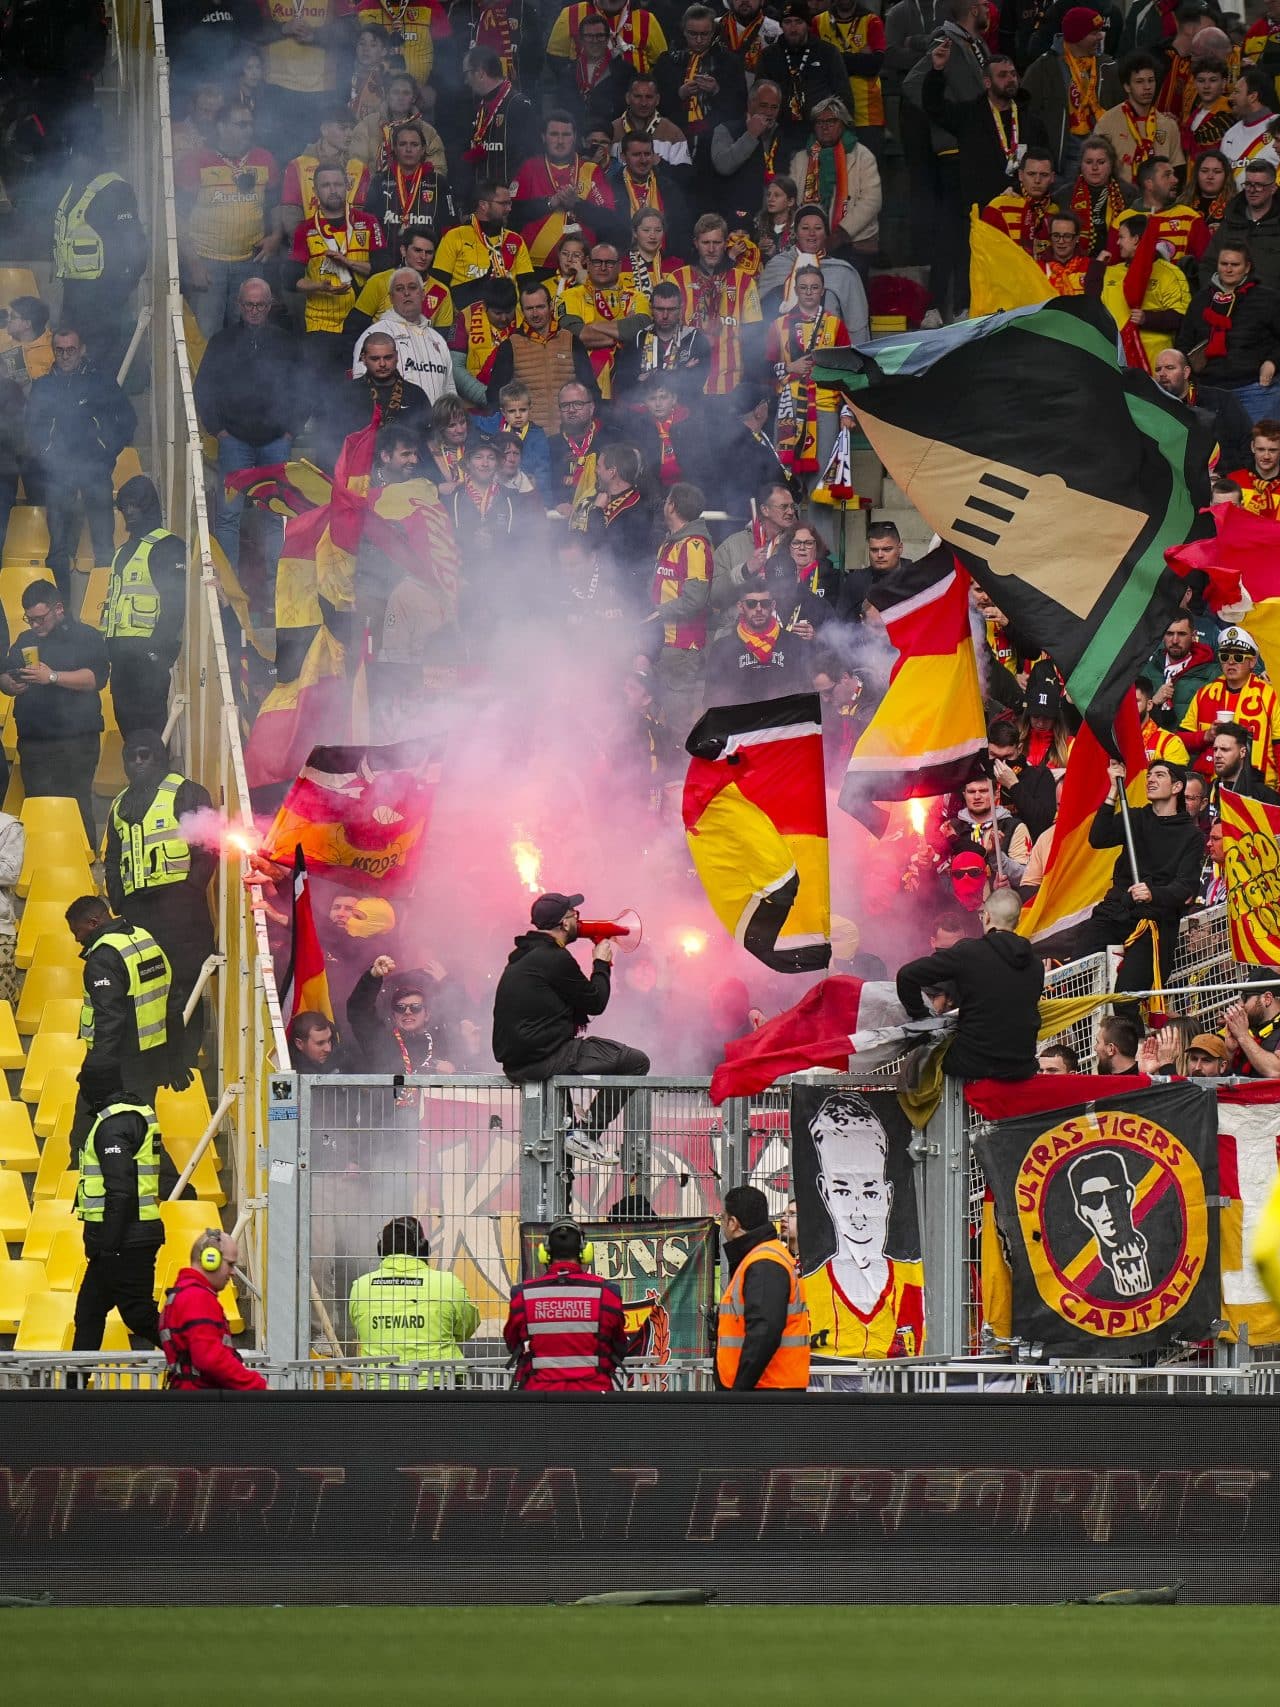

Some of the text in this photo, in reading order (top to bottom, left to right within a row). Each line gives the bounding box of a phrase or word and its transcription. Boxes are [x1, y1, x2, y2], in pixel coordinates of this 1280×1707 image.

[273, 4, 328, 17] Auhan
[384, 210, 432, 226] Auhan
[405, 357, 447, 374] Auchan
[1222, 639, 1251, 650] APTAIN
[1225, 832, 1280, 887] RED
[1018, 1115, 1184, 1212] ULTRAS TIGERS
[588, 1235, 690, 1280] ENS
[1058, 1254, 1201, 1336] CAPITALE
[534, 1300, 592, 1310] SECURITE
[372, 1314, 425, 1330] STEWARD
[534, 1309, 592, 1320] INCENDIE
